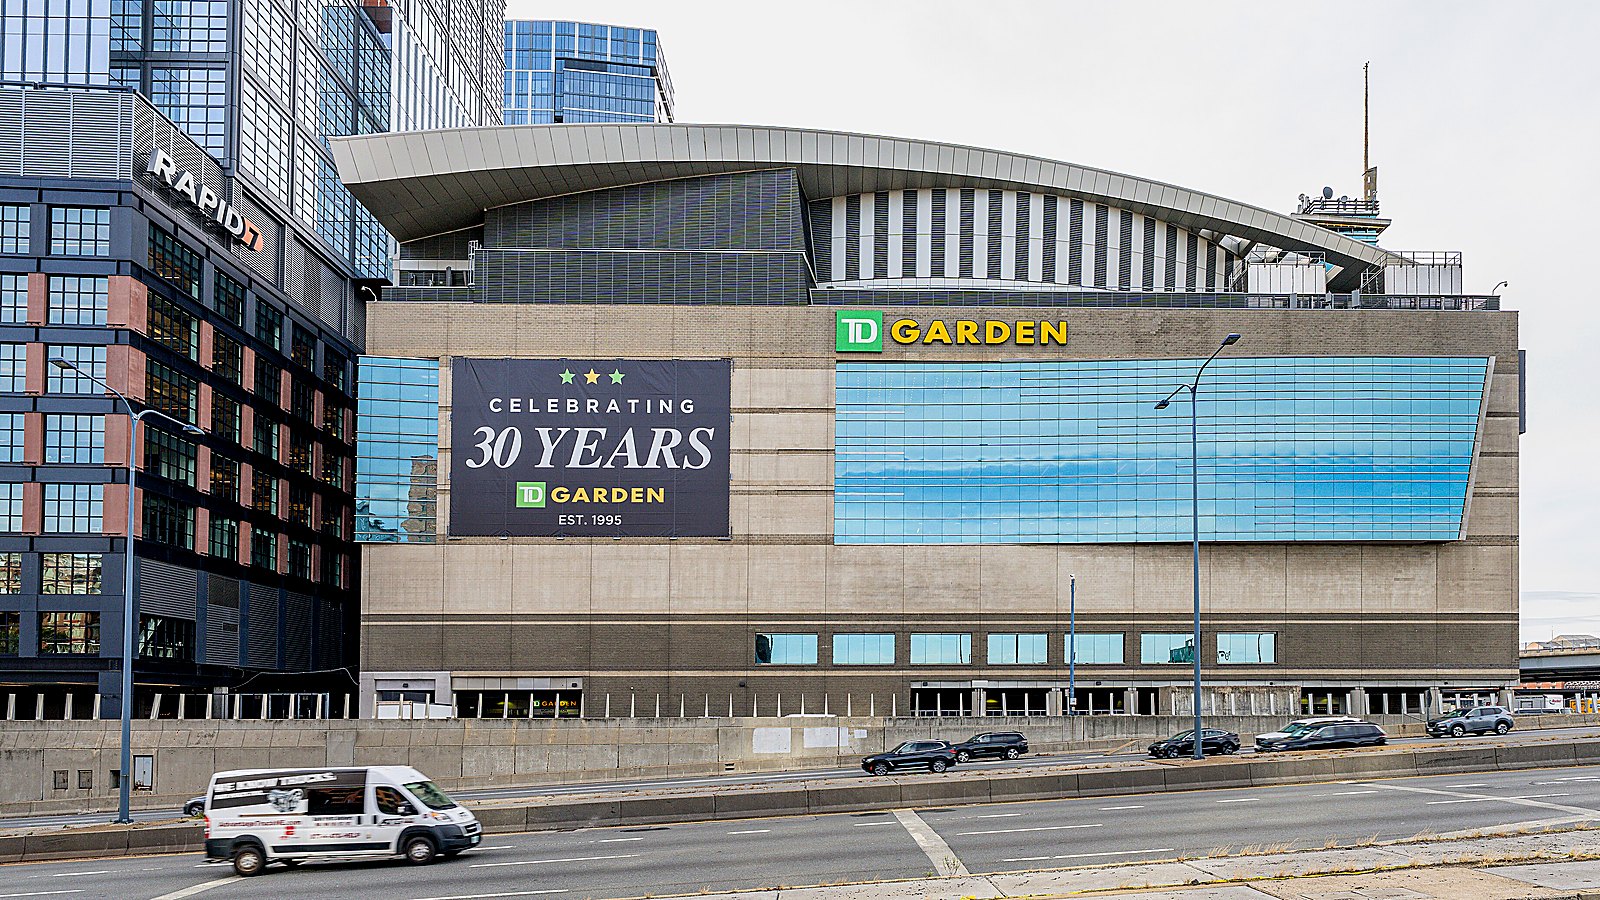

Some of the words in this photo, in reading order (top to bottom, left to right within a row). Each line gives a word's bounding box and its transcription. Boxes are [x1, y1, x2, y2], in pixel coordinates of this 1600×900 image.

[147, 148, 264, 252] RAPID7
[839, 317, 879, 345] TD
[890, 319, 1067, 345] GARDEN
[489, 398, 695, 414] CELEBRATING
[465, 426, 522, 468] 30
[534, 427, 715, 470] YEARS
[518, 485, 544, 504] TD
[551, 487, 665, 503] GARDEN
[558, 515, 588, 525] EST.
[591, 515, 622, 526] 1995
